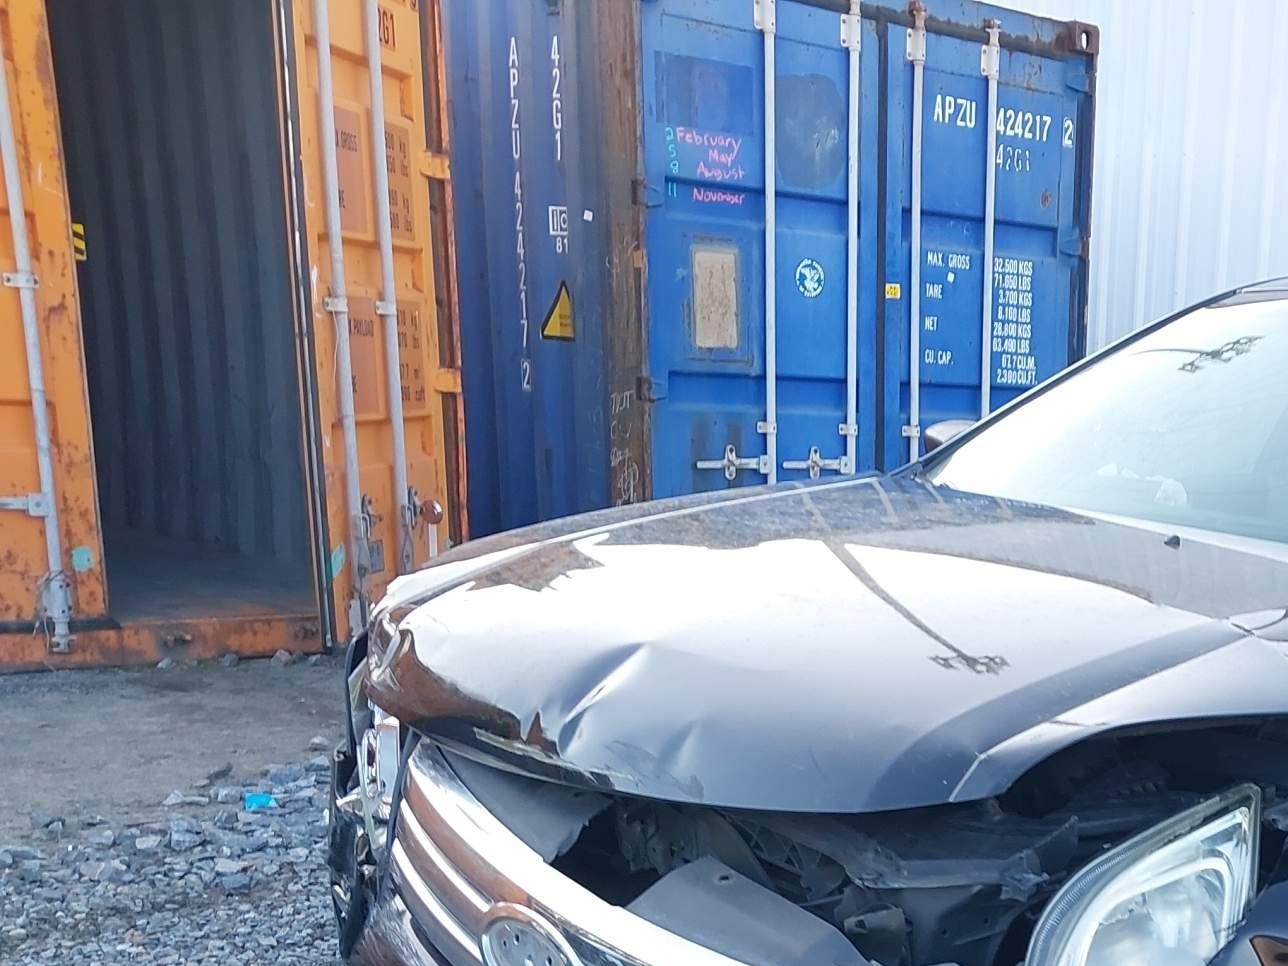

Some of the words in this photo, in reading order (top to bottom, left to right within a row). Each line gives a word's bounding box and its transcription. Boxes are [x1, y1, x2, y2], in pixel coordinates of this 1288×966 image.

[551, 35, 562, 161] 42G1
[933, 94, 977, 129] APZU
[996, 107, 1052, 142] 424217
[676, 127, 742, 160] February
[709, 148, 733, 168] May
[697, 161, 744, 181] August
[508, 36, 520, 159] APZU
[514, 171, 528, 349] 424217
[556, 237, 568, 254] 81
[948, 254, 970, 270] GROSS
[1019, 260, 1033, 276] KGS
[1019, 275, 1031, 291] LBS
[926, 283, 943, 299] TARE
[1019, 291, 1033, 307] KGS
[1018, 307, 1031, 323] LBS
[925, 316, 938, 331] NET
[1017, 323, 1032, 339] KGS
[1017, 339, 1030, 354] LBS
